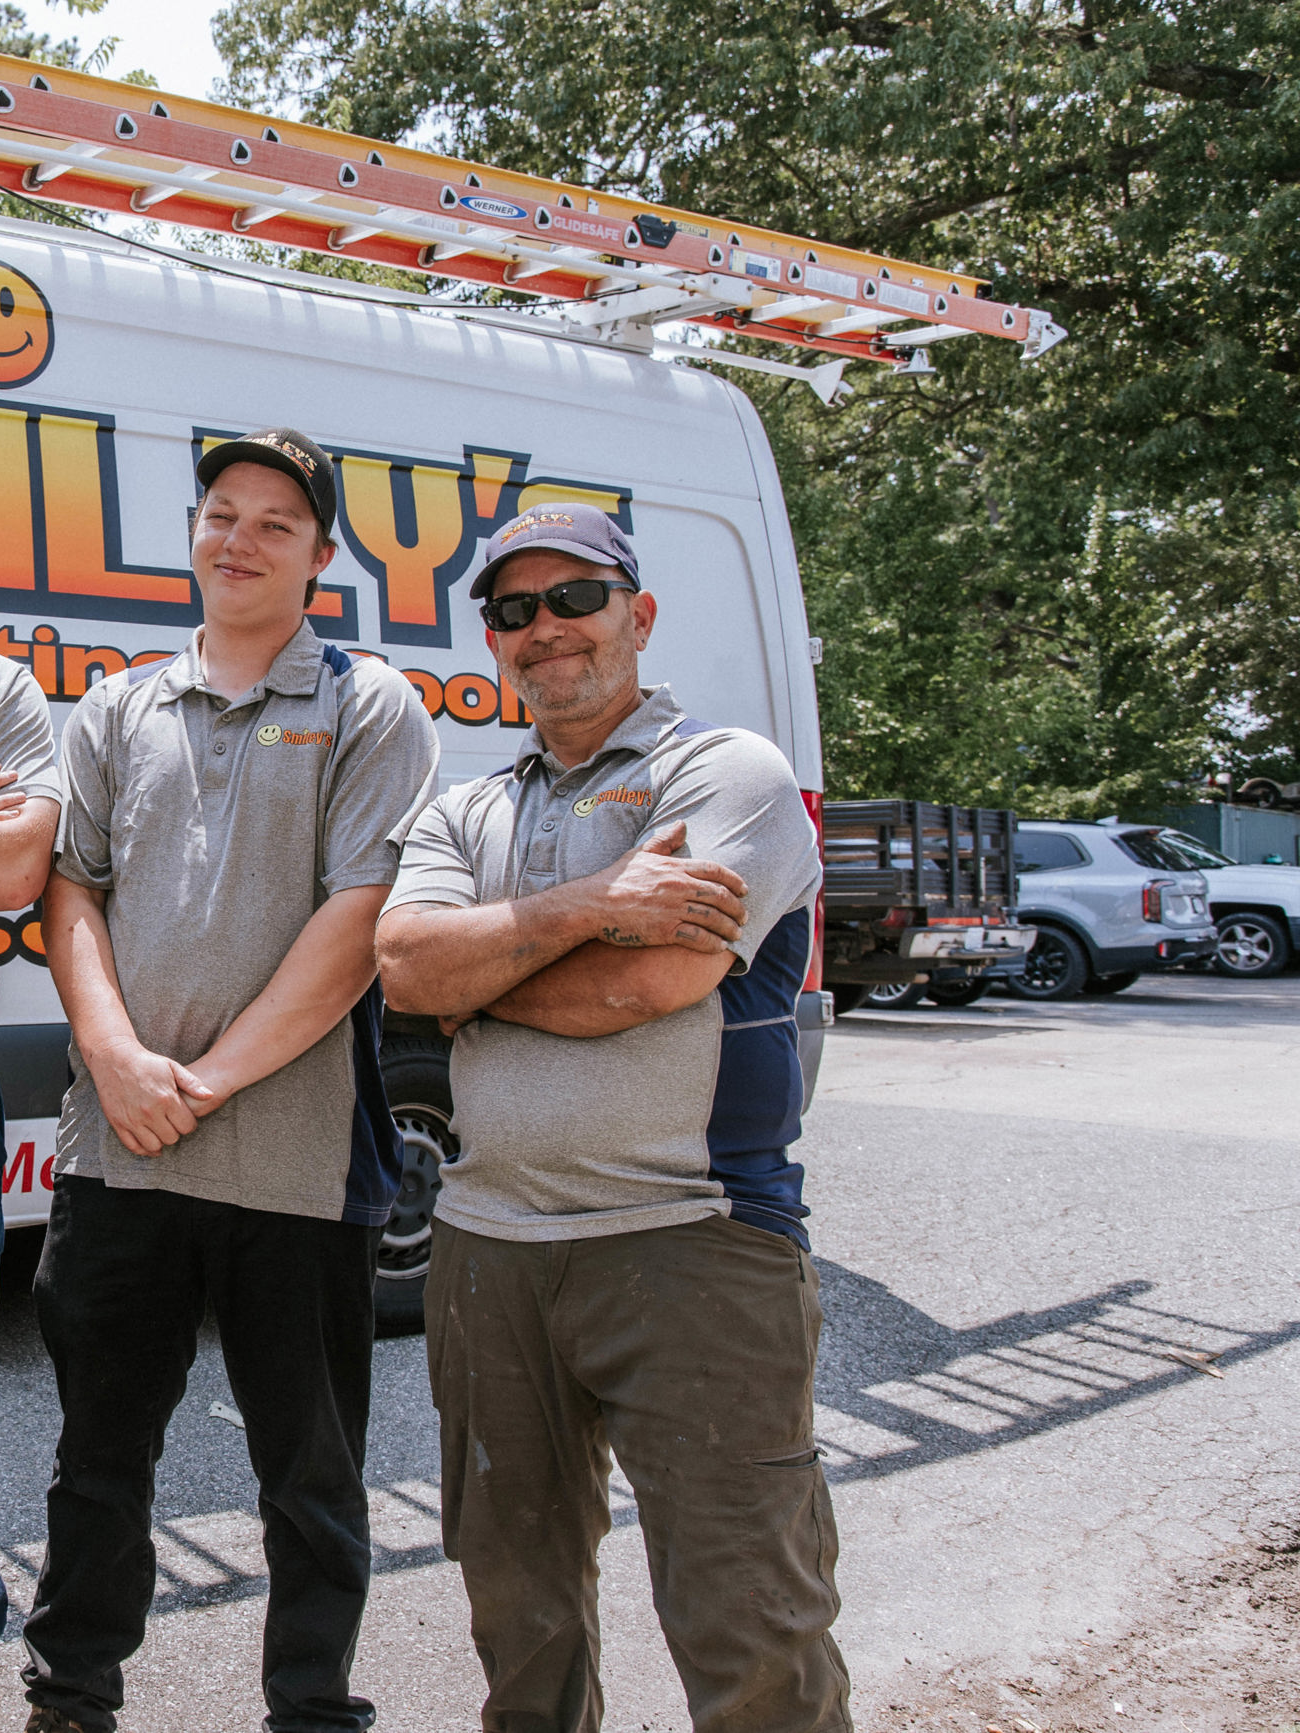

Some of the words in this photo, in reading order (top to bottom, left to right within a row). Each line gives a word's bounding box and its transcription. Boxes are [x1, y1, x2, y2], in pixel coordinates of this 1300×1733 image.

[473, 199, 515, 216] WERNER
[553, 215, 621, 242] GLIDESAFE
[281, 728, 333, 748] Smiley's
